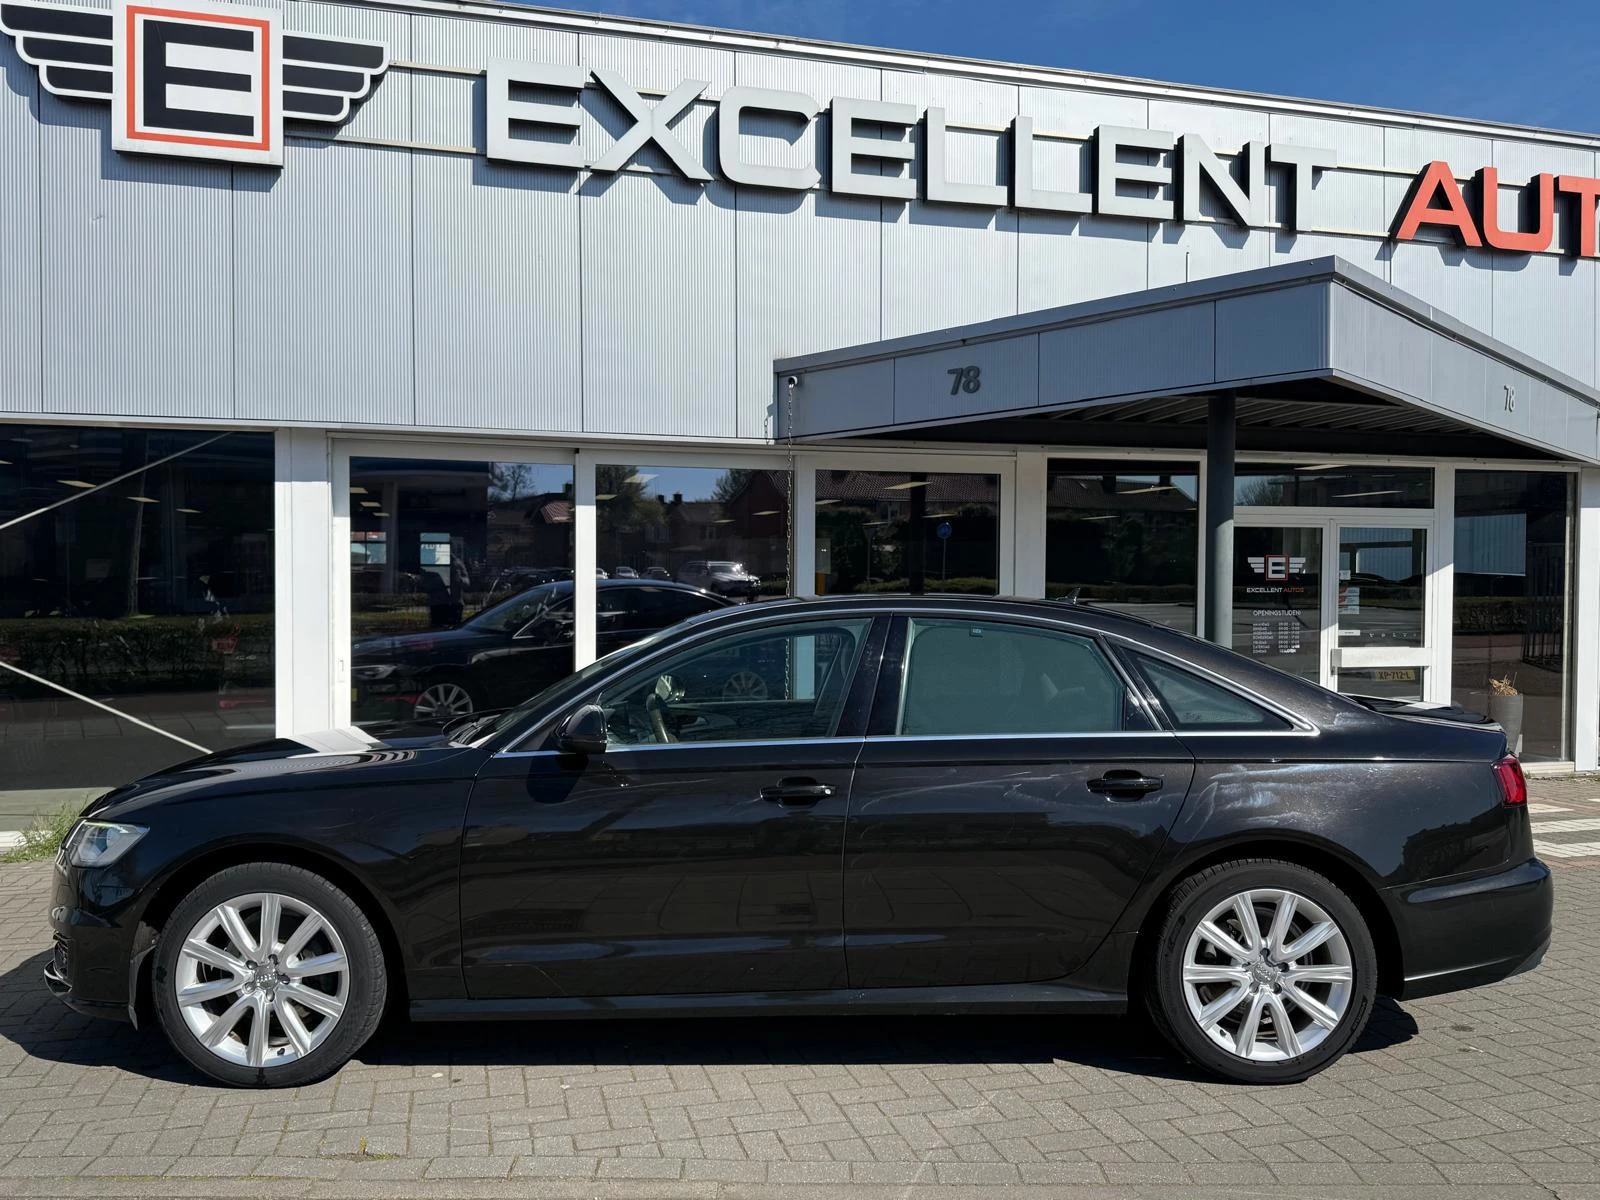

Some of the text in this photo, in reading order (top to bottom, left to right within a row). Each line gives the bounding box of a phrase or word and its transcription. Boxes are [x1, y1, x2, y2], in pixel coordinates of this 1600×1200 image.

[143, 19, 254, 137] E
[485, 57, 1600, 258] EXCELLENT AUT
[947, 365, 981, 396] 78
[1503, 384, 1516, 413] 78
[1268, 556, 1286, 579] E
